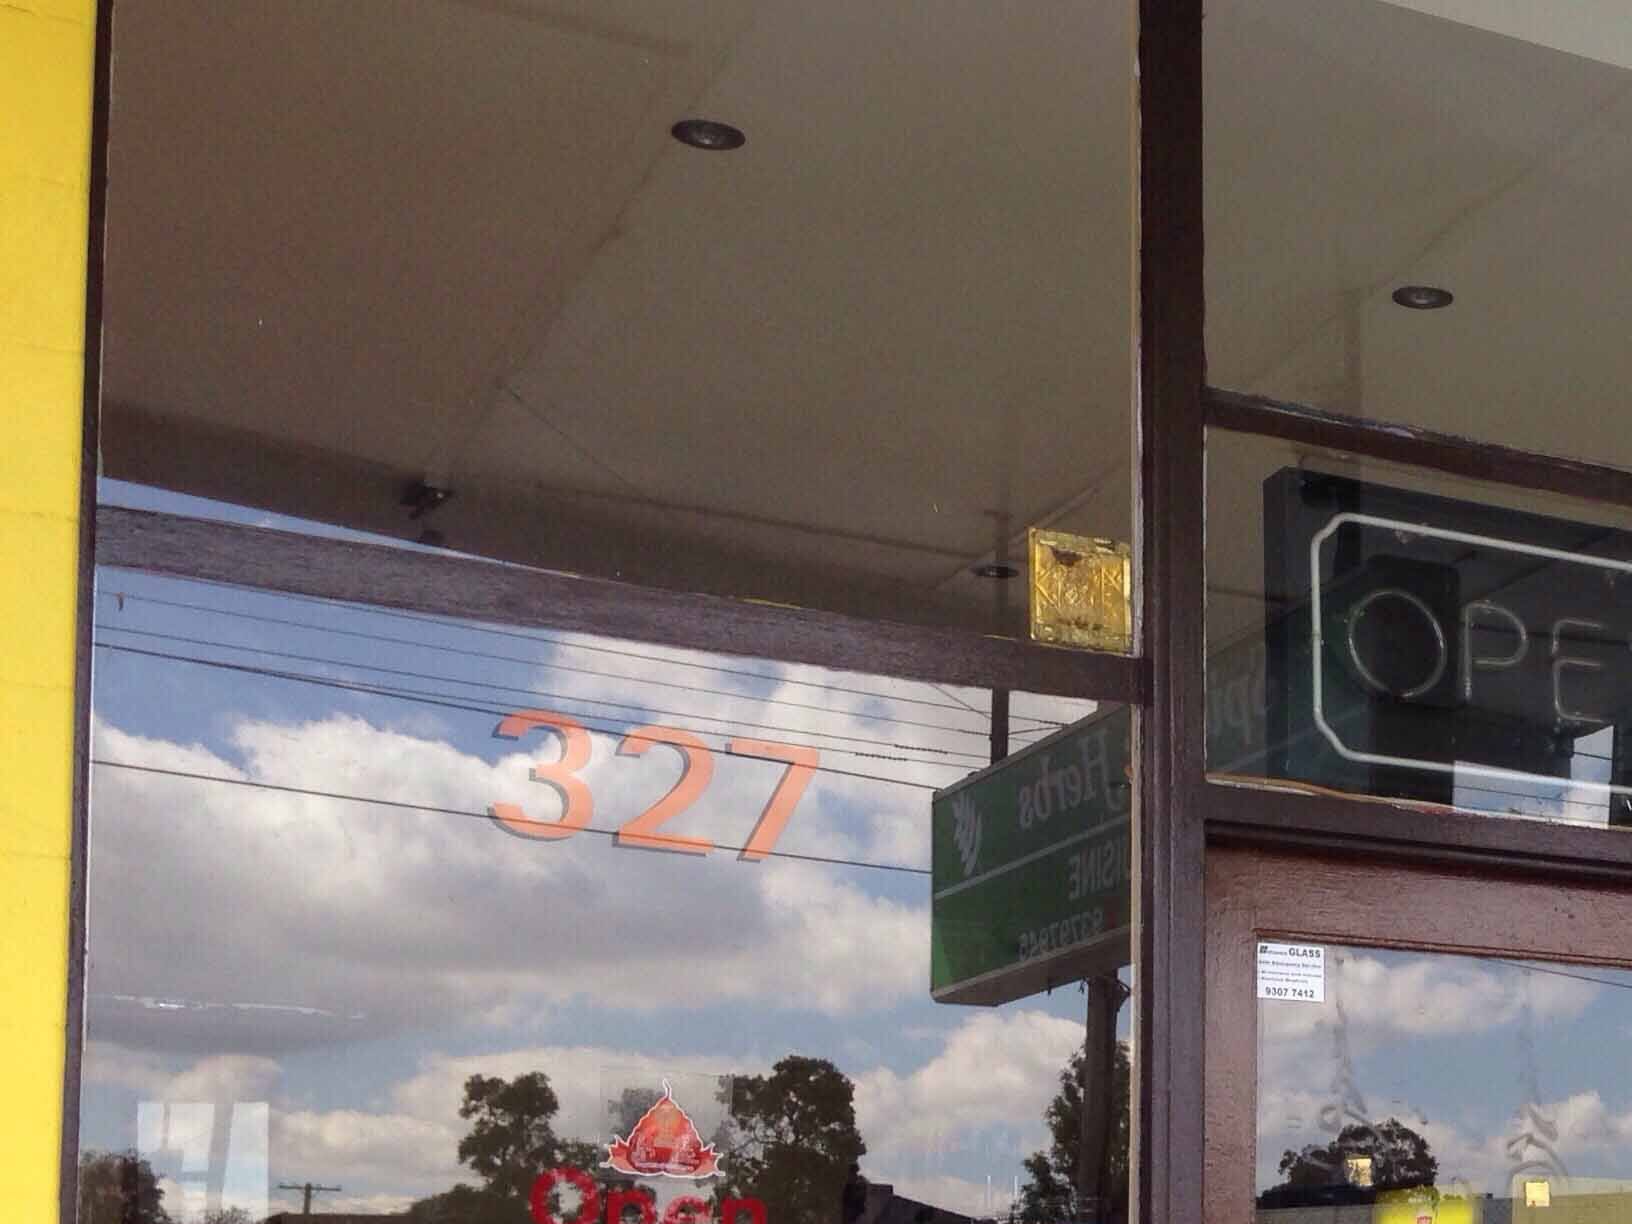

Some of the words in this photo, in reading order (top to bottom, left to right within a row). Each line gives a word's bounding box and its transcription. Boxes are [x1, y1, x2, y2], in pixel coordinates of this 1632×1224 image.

[487, 708, 821, 862] 327
[1288, 947, 1321, 958] GLASS
[1265, 986, 1289, 996] 9307
